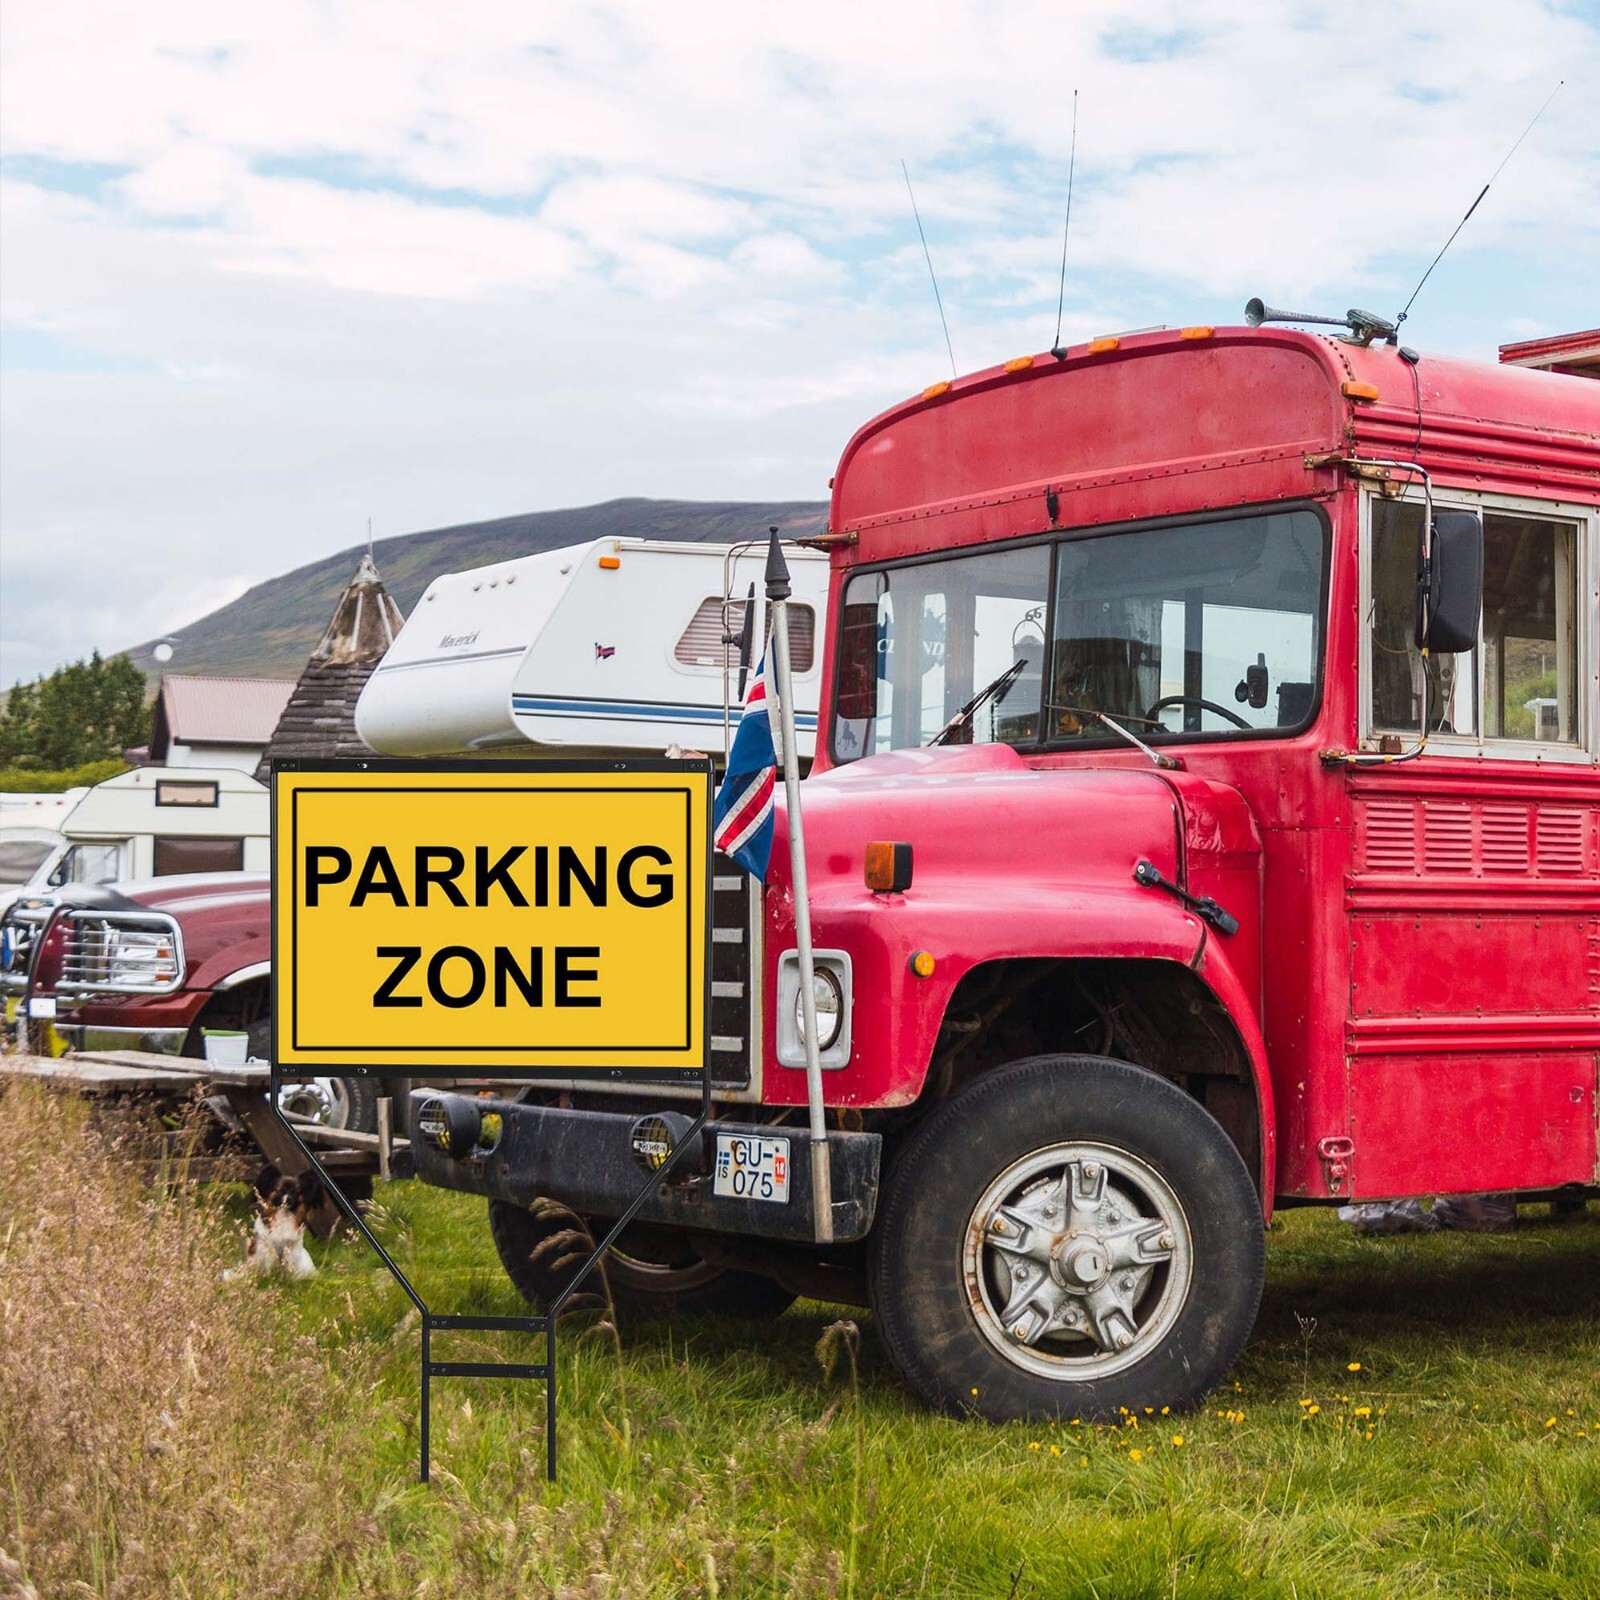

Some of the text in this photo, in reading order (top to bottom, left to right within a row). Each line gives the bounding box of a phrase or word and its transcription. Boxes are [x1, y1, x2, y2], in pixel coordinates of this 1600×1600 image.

[306, 846, 673, 908] PARKING
[374, 946, 601, 1008] ZONE
[718, 1166, 729, 1179] IS
[775, 1161, 785, 1176] 18
[733, 1170, 774, 1198] 075
